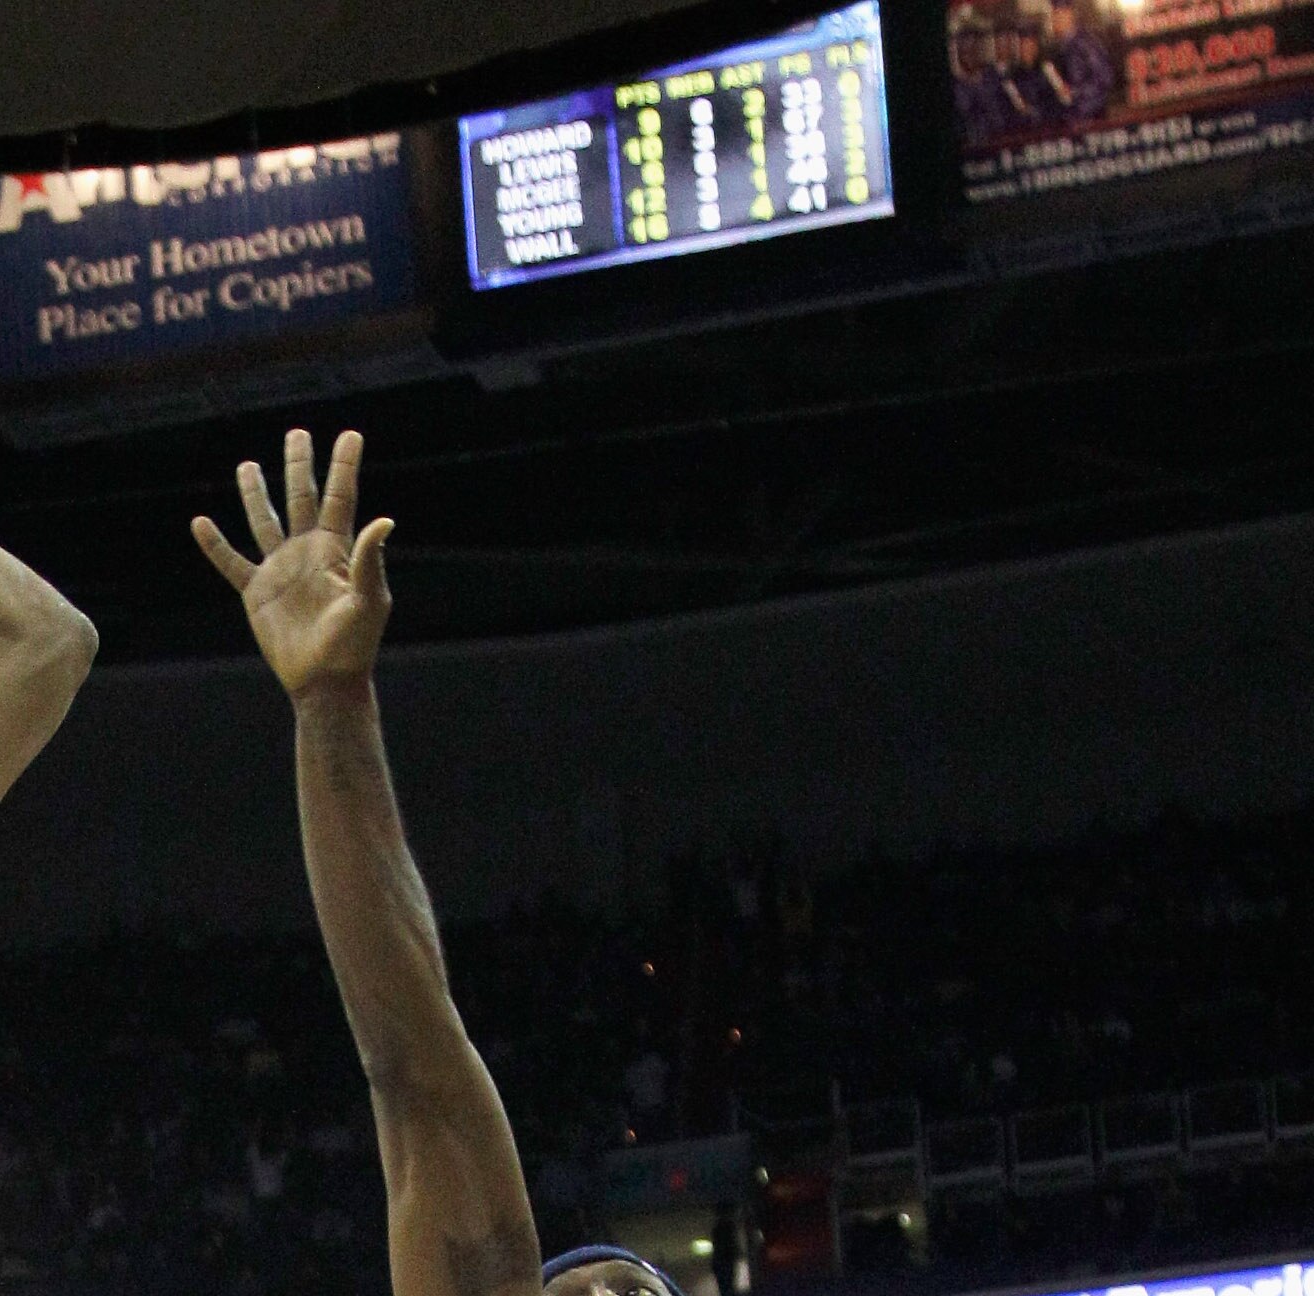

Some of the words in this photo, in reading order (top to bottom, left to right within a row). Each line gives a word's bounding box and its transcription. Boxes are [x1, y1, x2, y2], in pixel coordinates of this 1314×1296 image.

[615, 80, 661, 108] PTS
[720, 60, 765, 90] AST
[481, 120, 593, 165] HOWARD
[498, 150, 578, 187] LEWIS
[498, 200, 584, 238] YOUNG
[505, 229, 580, 265] WALL
[749, 192, 774, 221] 4
[45, 253, 140, 297] Your
[149, 213, 367, 279] Hometown
[38, 300, 142, 345] Place
[152, 285, 212, 326] for
[217, 258, 375, 312] Copiers
